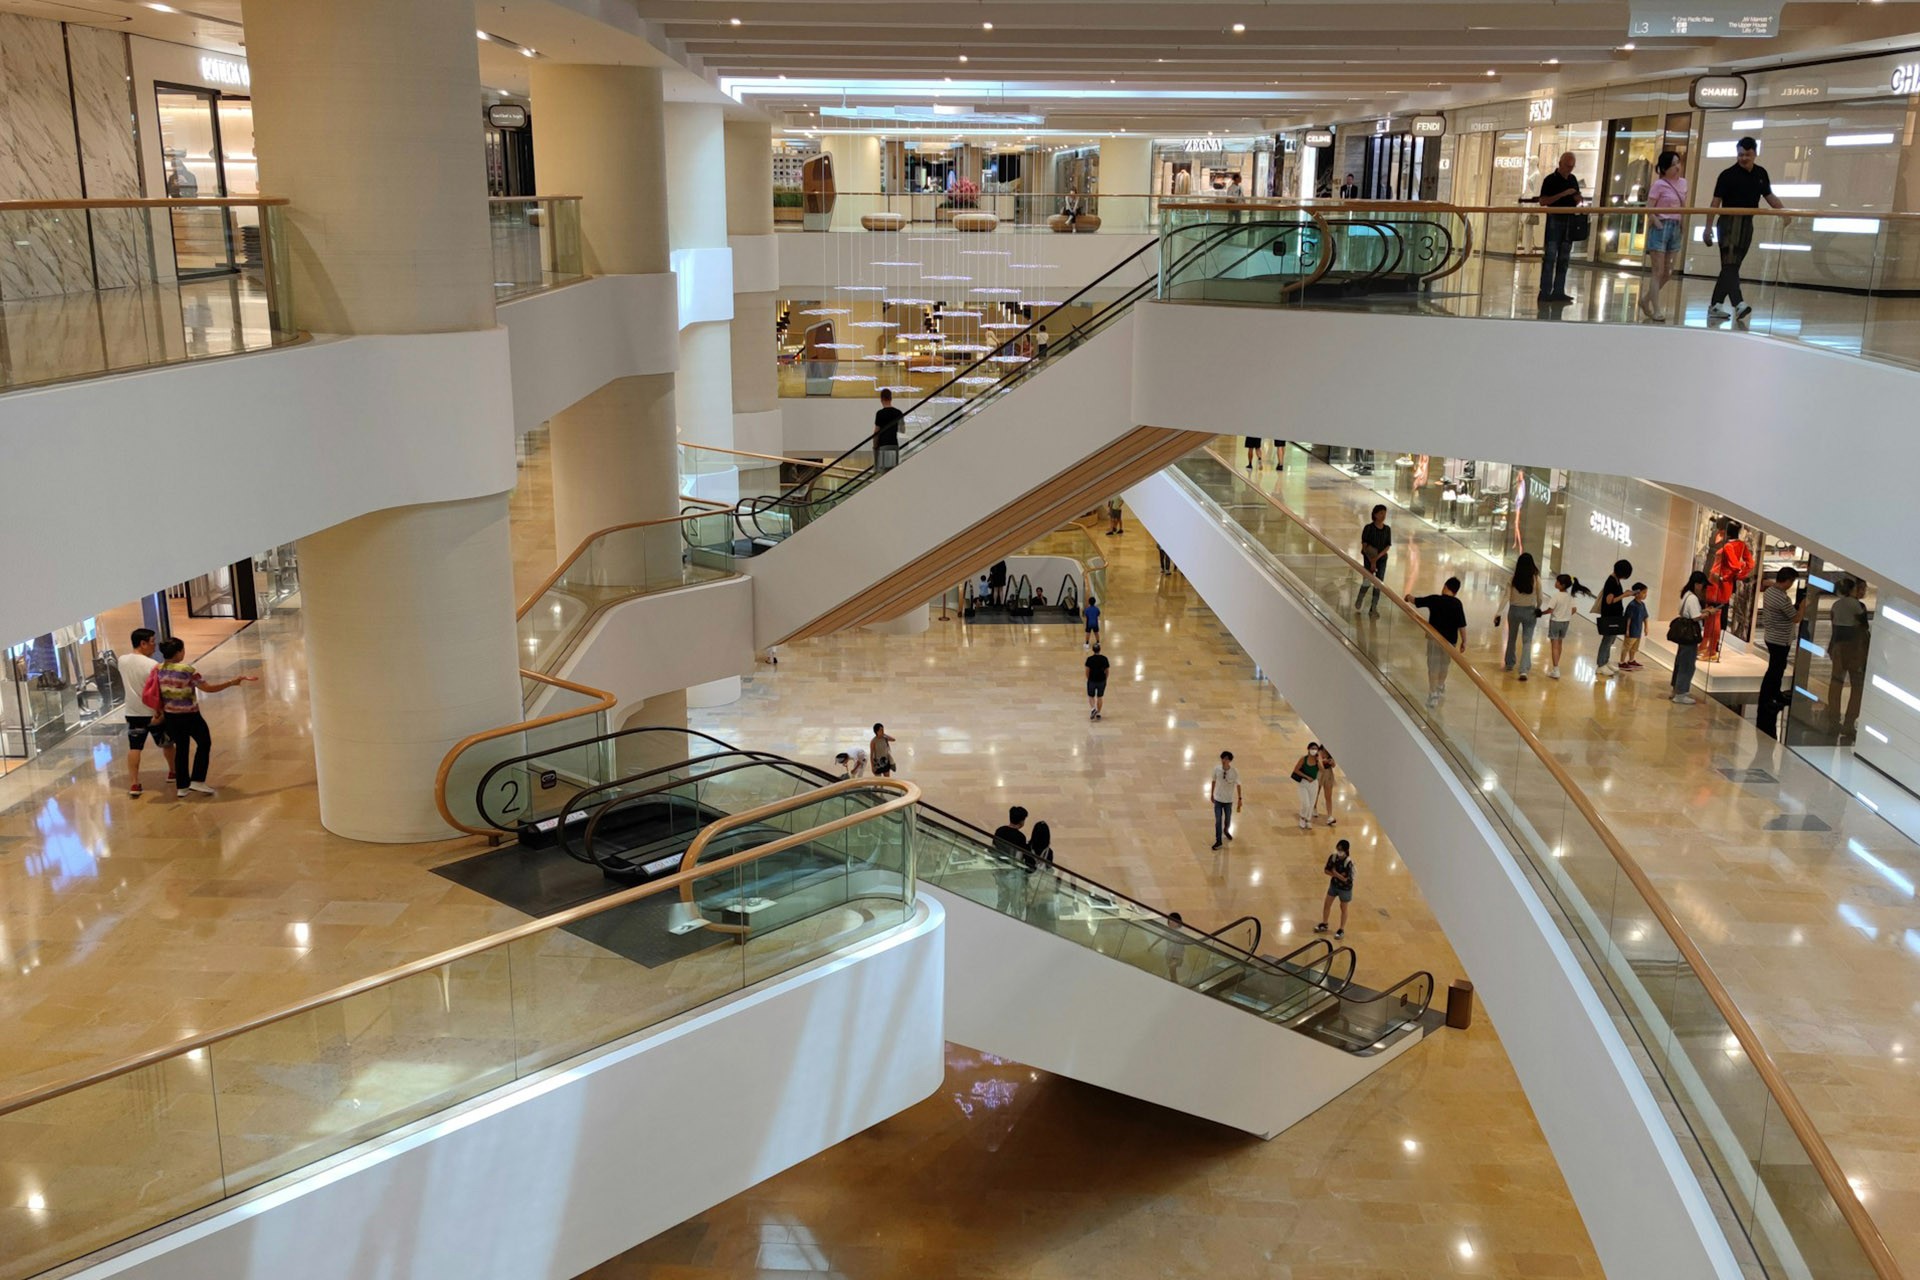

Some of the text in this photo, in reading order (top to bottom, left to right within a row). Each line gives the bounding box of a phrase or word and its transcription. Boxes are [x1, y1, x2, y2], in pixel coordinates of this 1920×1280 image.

[1634, 22, 1649, 34] L3
[1701, 87, 1739, 96] CHANEL
[1416, 122, 1440, 131] FENDI
[1184, 138, 1222, 152] ZEGNA
[1306, 135, 1331, 143] CELINE
[1418, 236, 1434, 261] 3
[1590, 510, 1632, 547] CHANEL
[501, 780, 520, 814] 2
